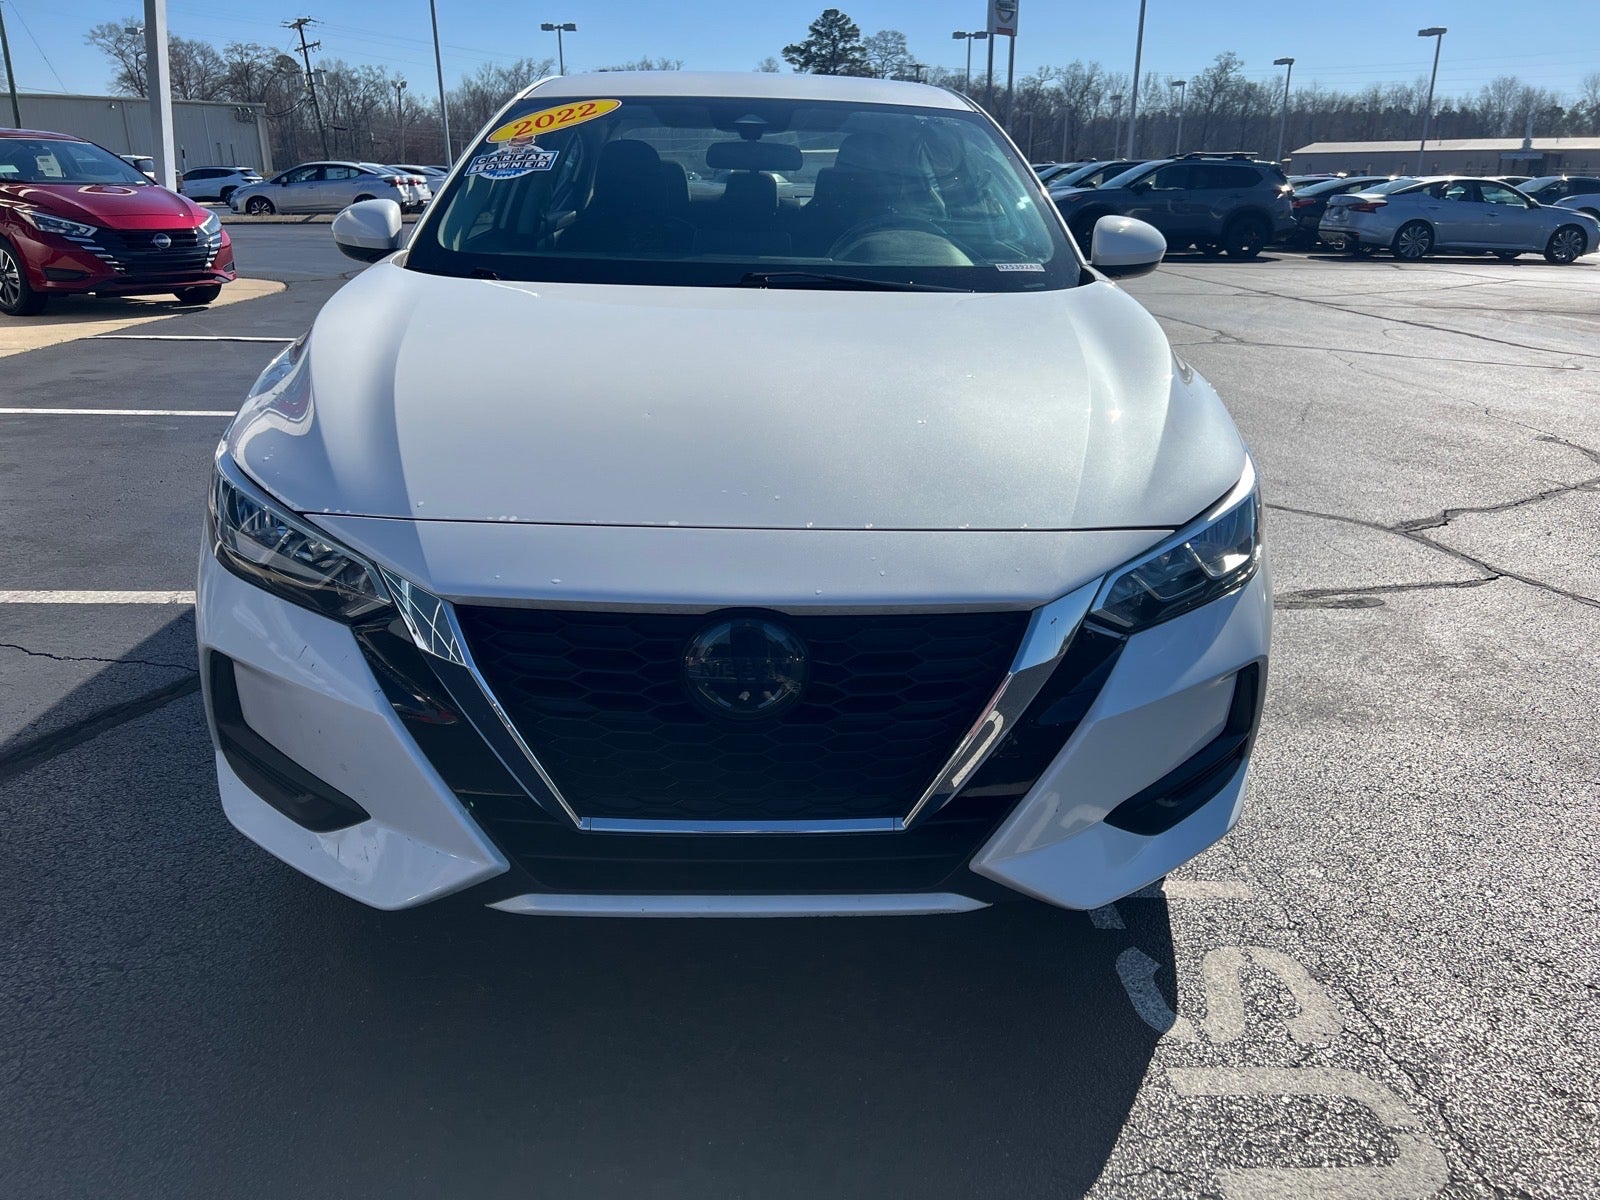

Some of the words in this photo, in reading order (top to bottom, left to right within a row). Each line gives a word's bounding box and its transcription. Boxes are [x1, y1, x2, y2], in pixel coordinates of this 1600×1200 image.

[514, 103, 597, 136] 2022
[477, 154, 551, 164] CARFAX
[485, 161, 546, 170] OWNER
